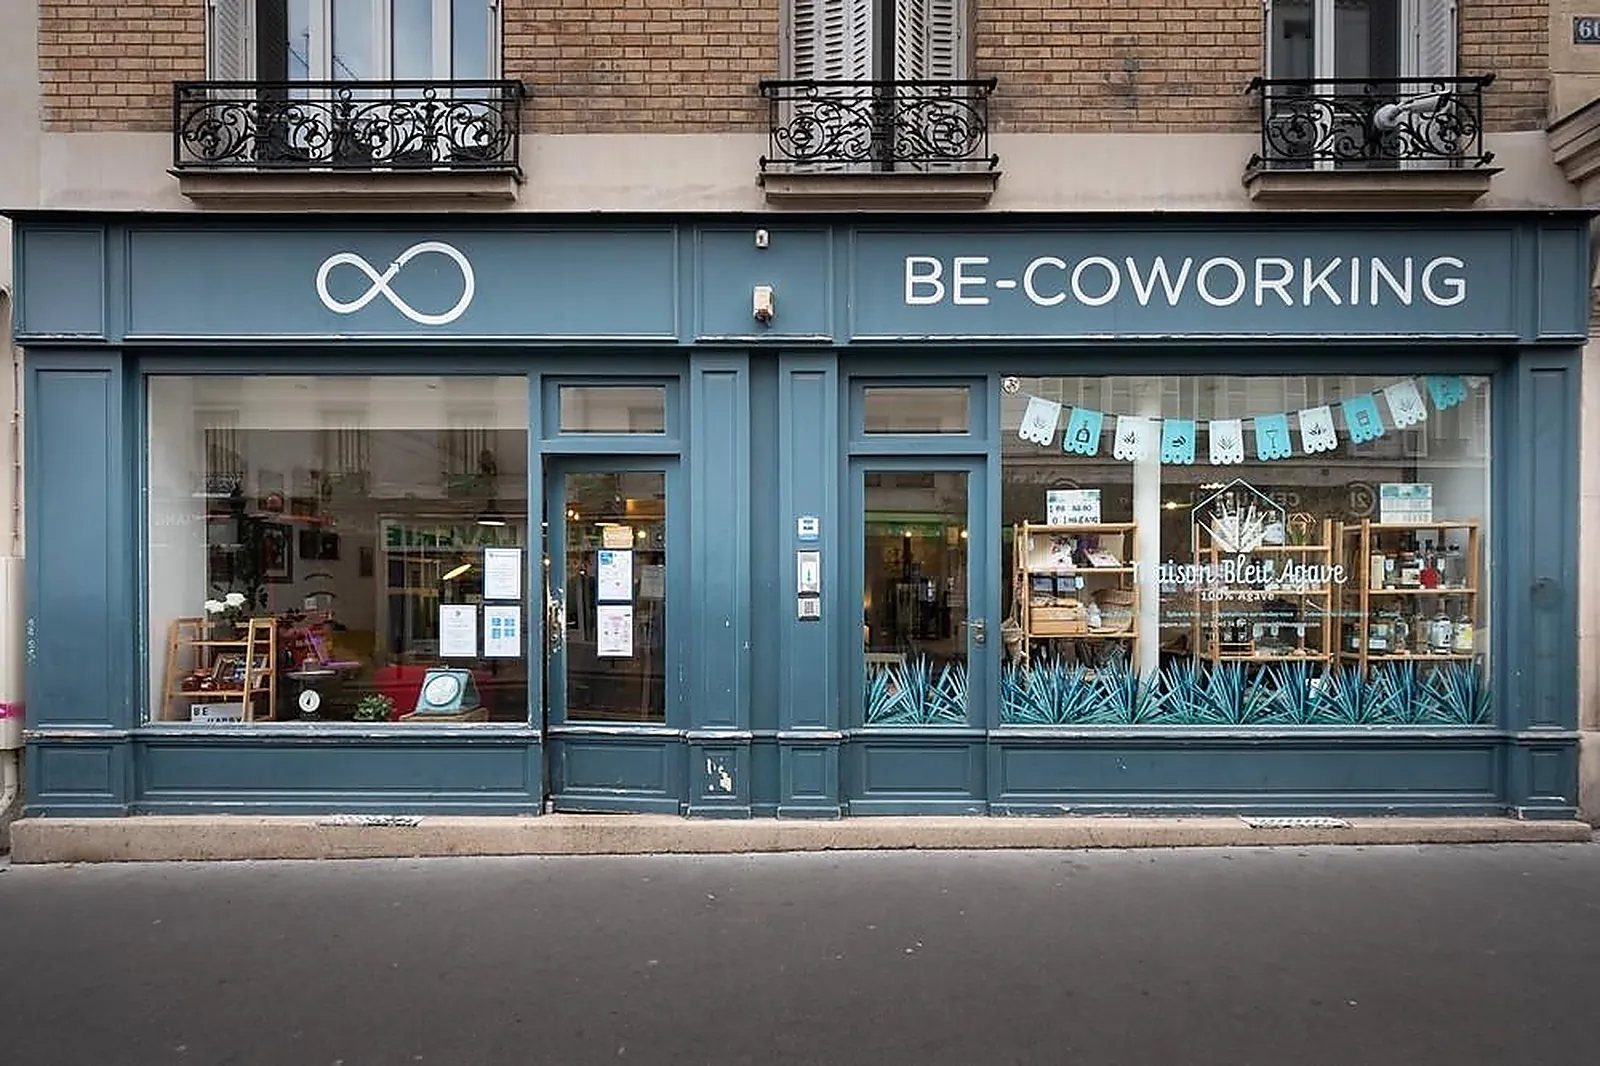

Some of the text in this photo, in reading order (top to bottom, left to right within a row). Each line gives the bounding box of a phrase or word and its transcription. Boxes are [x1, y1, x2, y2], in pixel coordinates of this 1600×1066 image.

[905, 256, 1467, 307] BE-COWORKING
[1221, 554, 1274, 584] Bleu
[1276, 558, 1348, 593] Agave
[1201, 591, 1234, 601] 100%
[193, 706, 209, 716] BE
